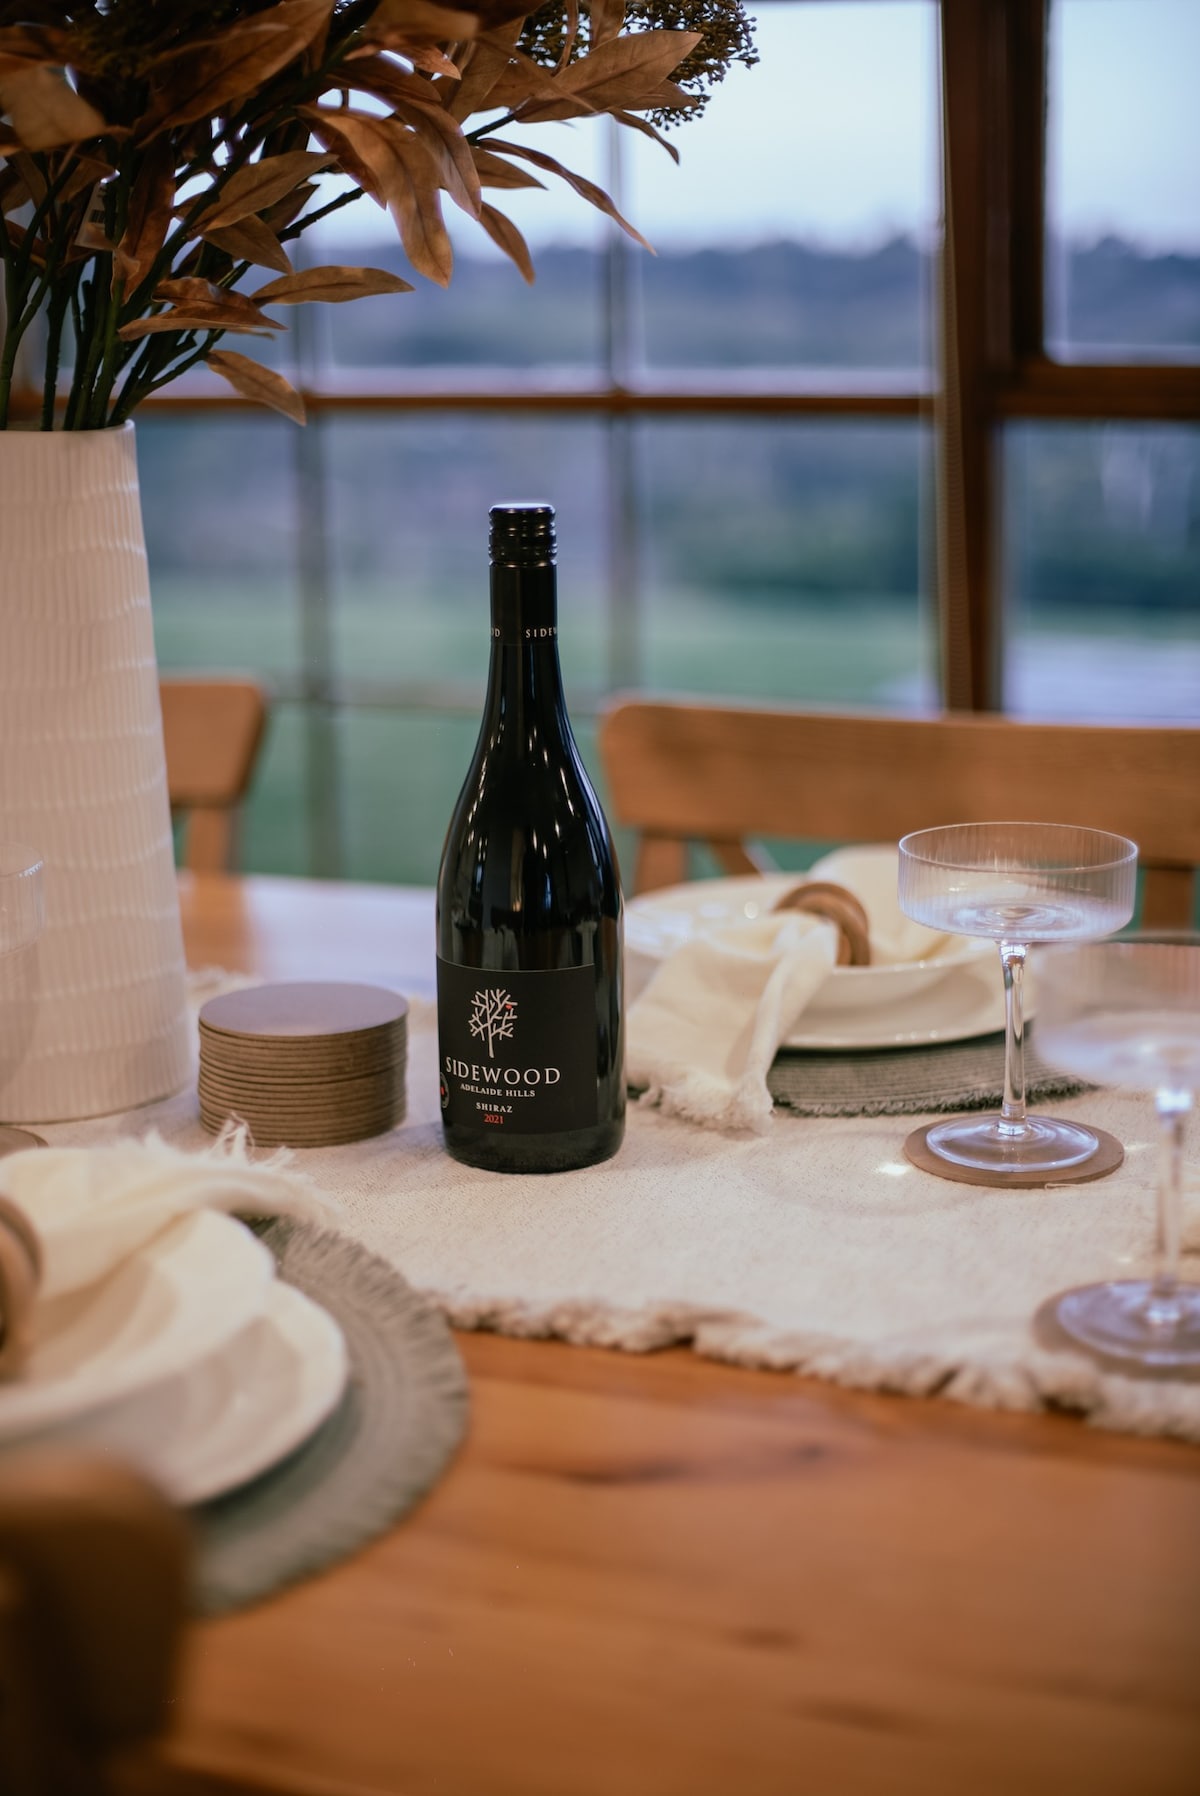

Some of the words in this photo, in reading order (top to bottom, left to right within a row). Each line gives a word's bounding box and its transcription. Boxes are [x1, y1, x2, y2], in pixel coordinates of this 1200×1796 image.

[446, 1056, 561, 1085] SIDEWOOD
[460, 1083, 503, 1097] ADELAIDE
[505, 1089, 536, 1098] HILLS
[475, 1102, 513, 1113] SHIRAZ
[484, 1114, 504, 1124] 2021
